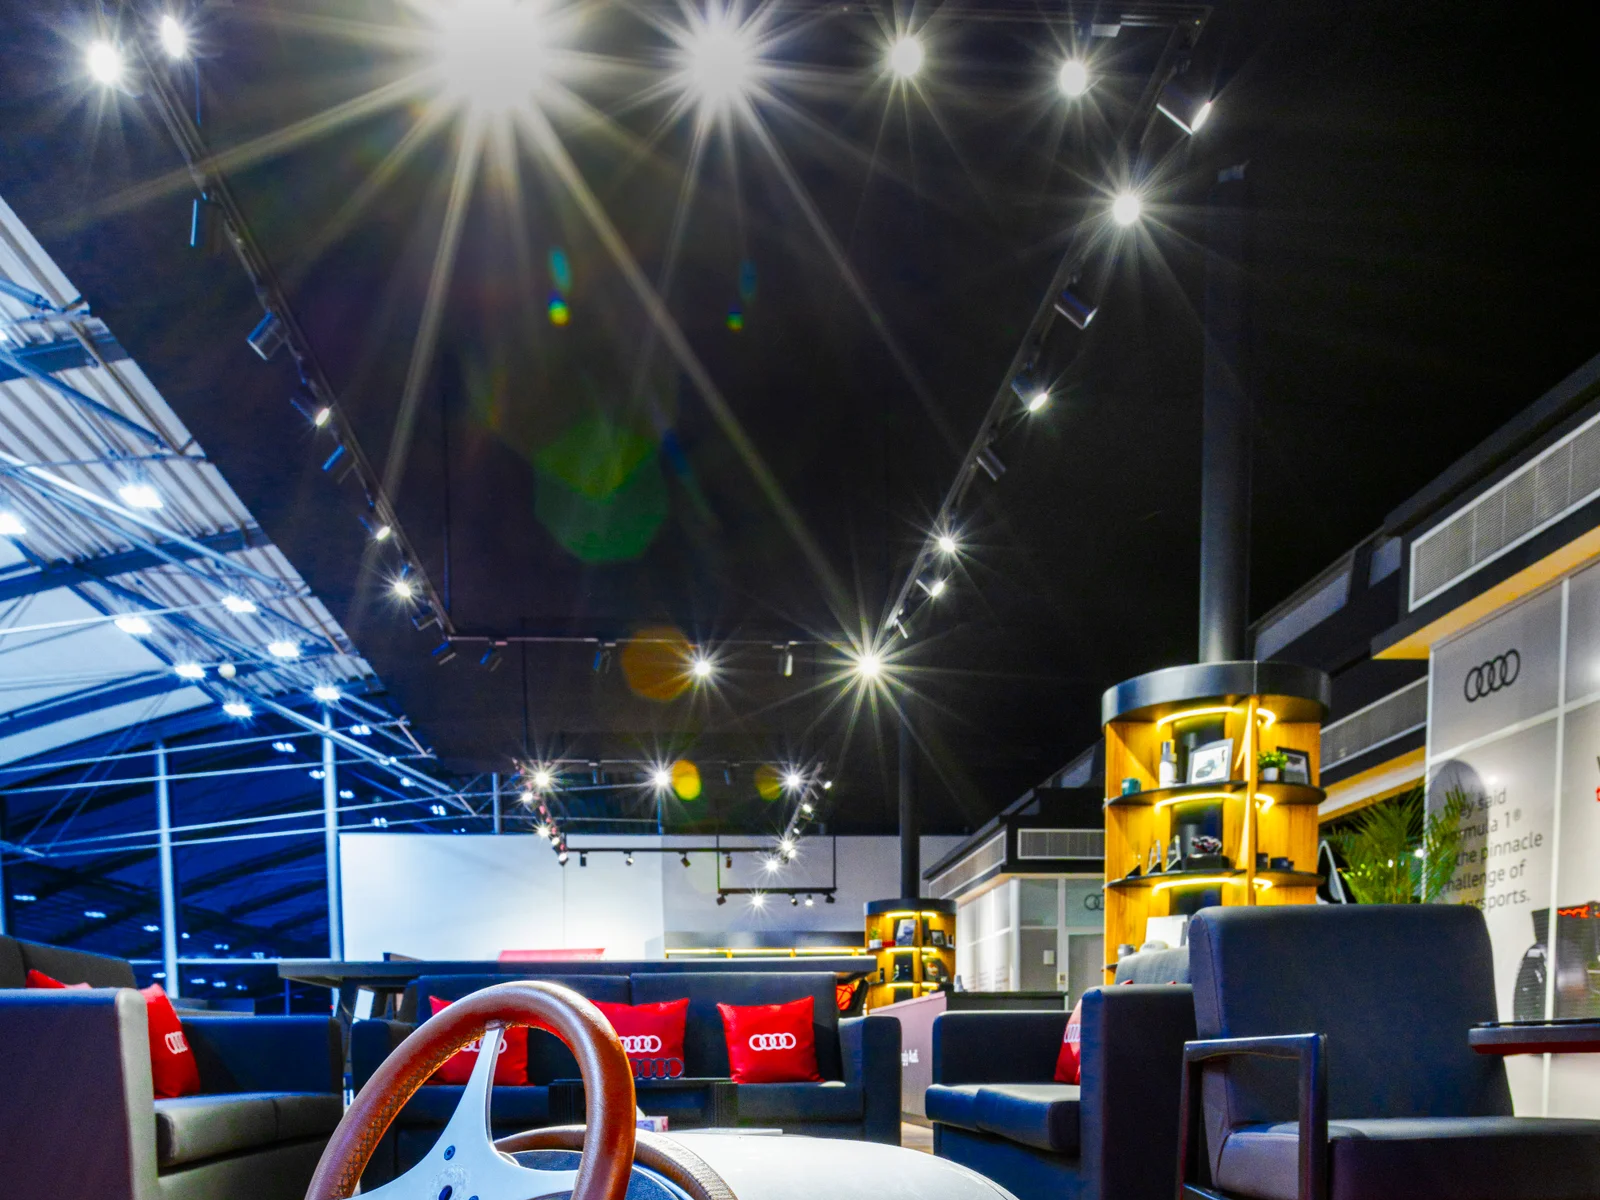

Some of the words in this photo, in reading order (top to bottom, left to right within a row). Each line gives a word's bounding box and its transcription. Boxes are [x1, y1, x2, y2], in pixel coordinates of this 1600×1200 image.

[1478, 788, 1507, 812] said
[1480, 831, 1543, 866] pinnacle
[1442, 867, 1505, 895] hallenge
[1509, 858, 1527, 879] of
